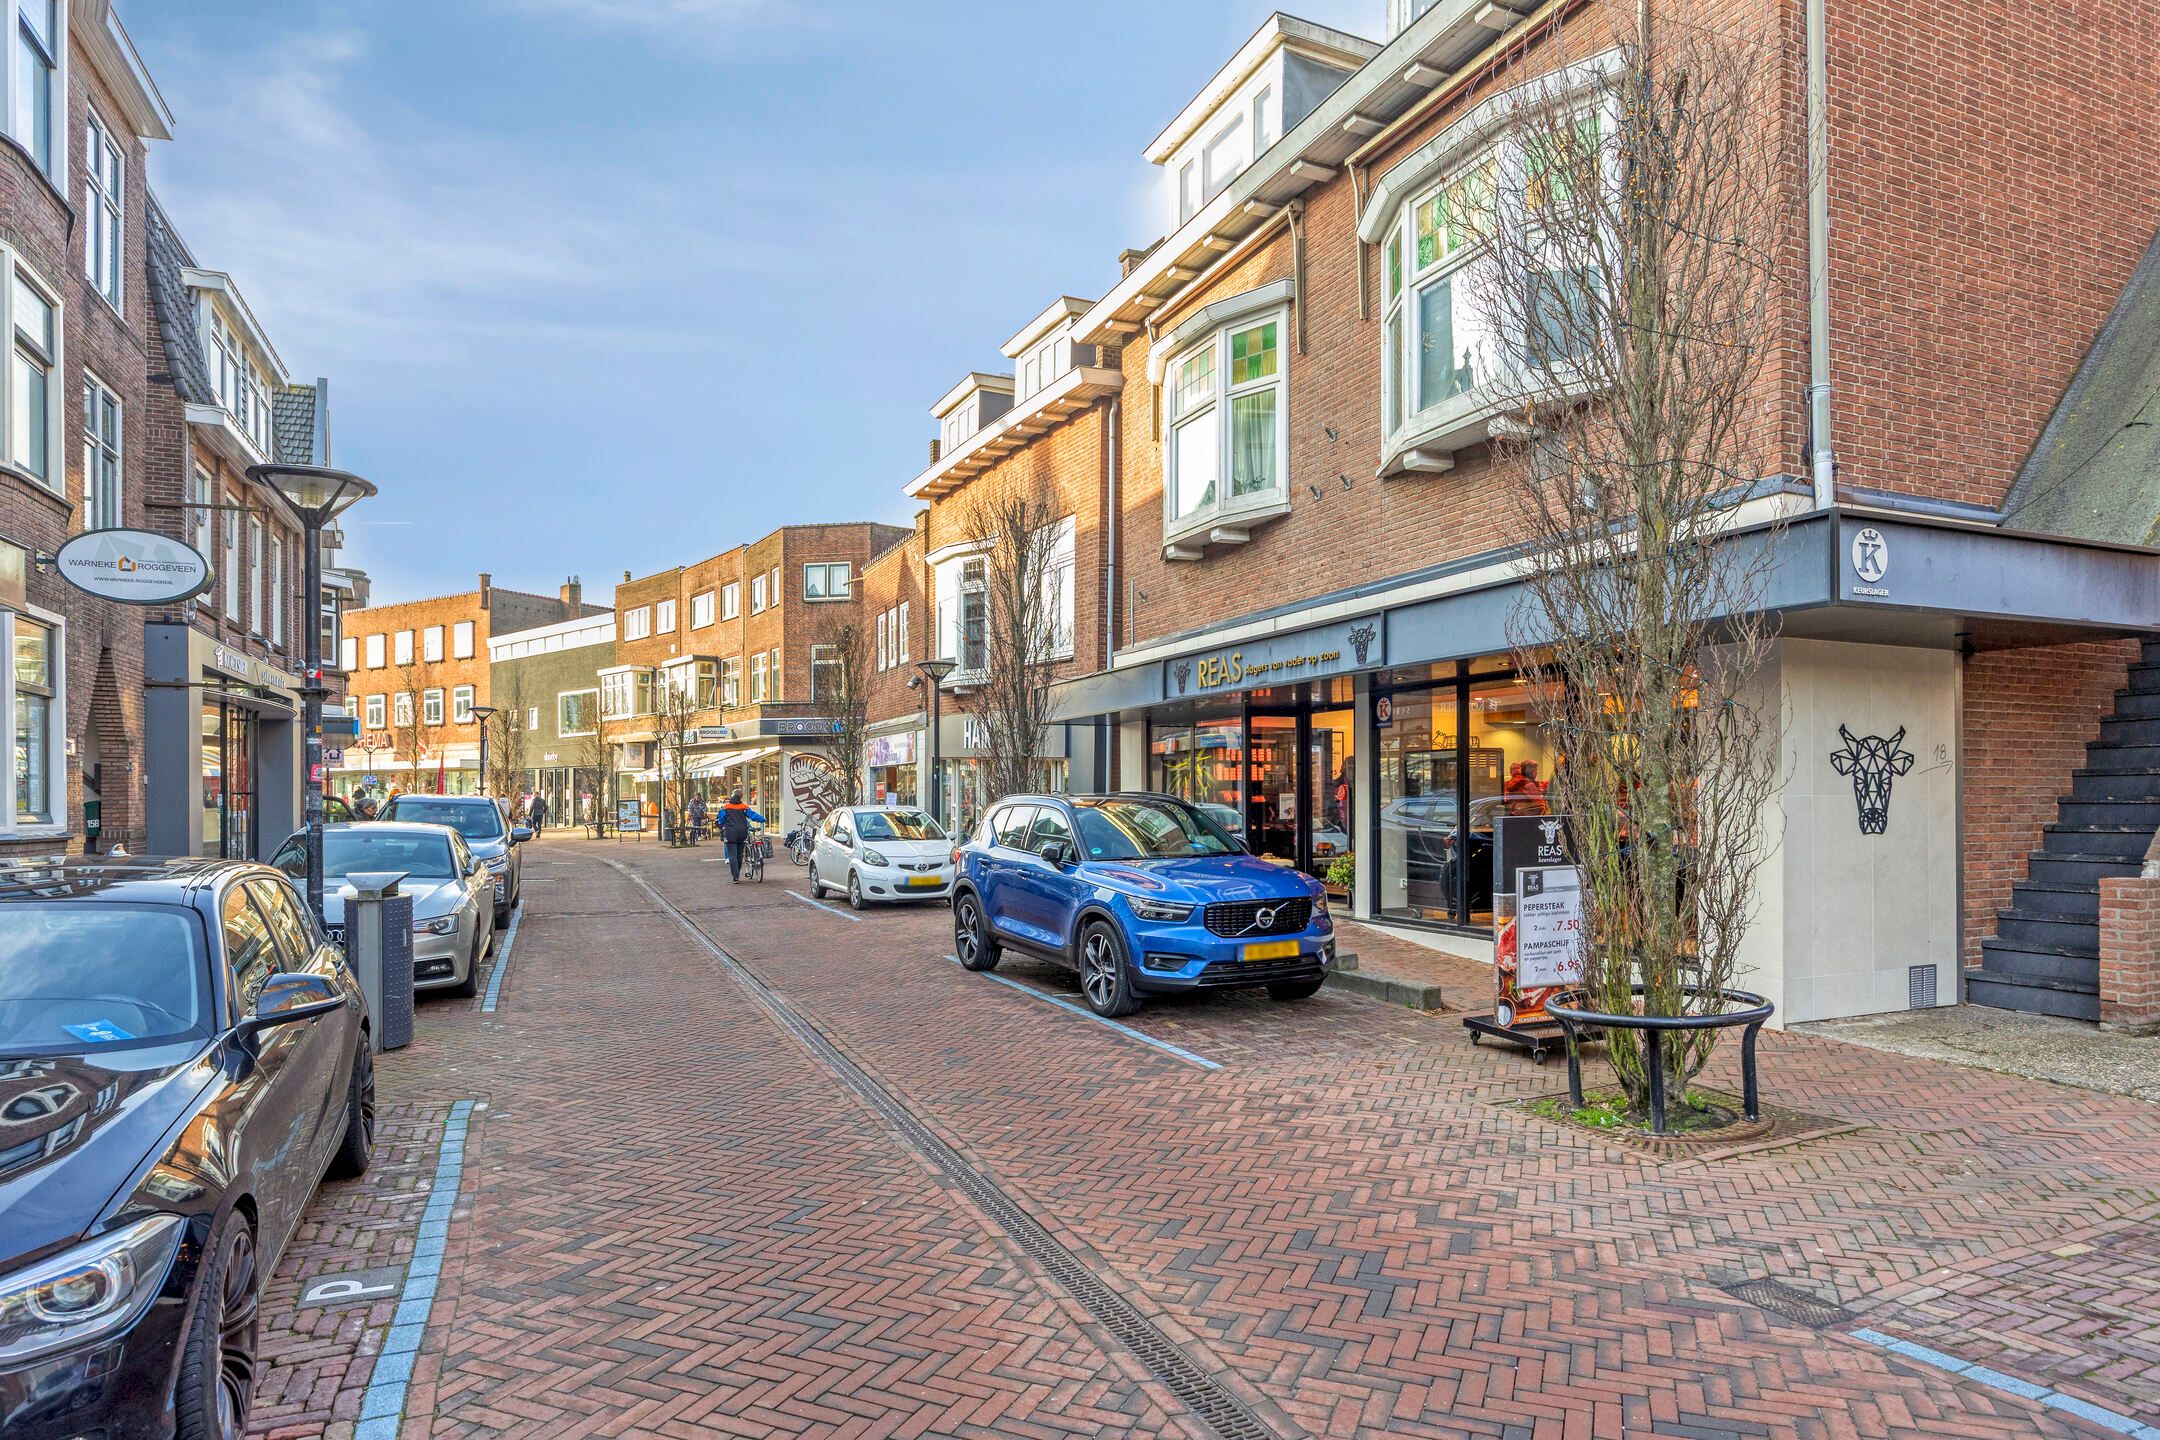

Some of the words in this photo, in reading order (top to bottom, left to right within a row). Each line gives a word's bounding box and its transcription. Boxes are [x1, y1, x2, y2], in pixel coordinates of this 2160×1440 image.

[1858, 542, 1882, 575] K
[68, 559, 117, 569] WARNEKE
[137, 563, 196, 573] ROGGEVEEN
[93, 576, 174, 585] WWW.WARNEKE-ROGGEVEEN.NL
[1853, 586, 1889, 597] KEURSLAGER
[1198, 652, 1242, 688] REAS
[1245, 663, 1269, 676] slagers
[1271, 661, 1283, 670] van
[1285, 655, 1305, 667] vader
[1307, 654, 1317, 665] op
[1320, 650, 1339, 661] zoon
[360, 733, 389, 749] HEMA
[1933, 744, 1947, 761] 18
[1538, 845, 1562, 857] REAS
[1523, 902, 1565, 911] PEPERSTEAK
[1557, 919, 1580, 931] 7.50
[1523, 940, 1569, 950] PAMPASCHIJF
